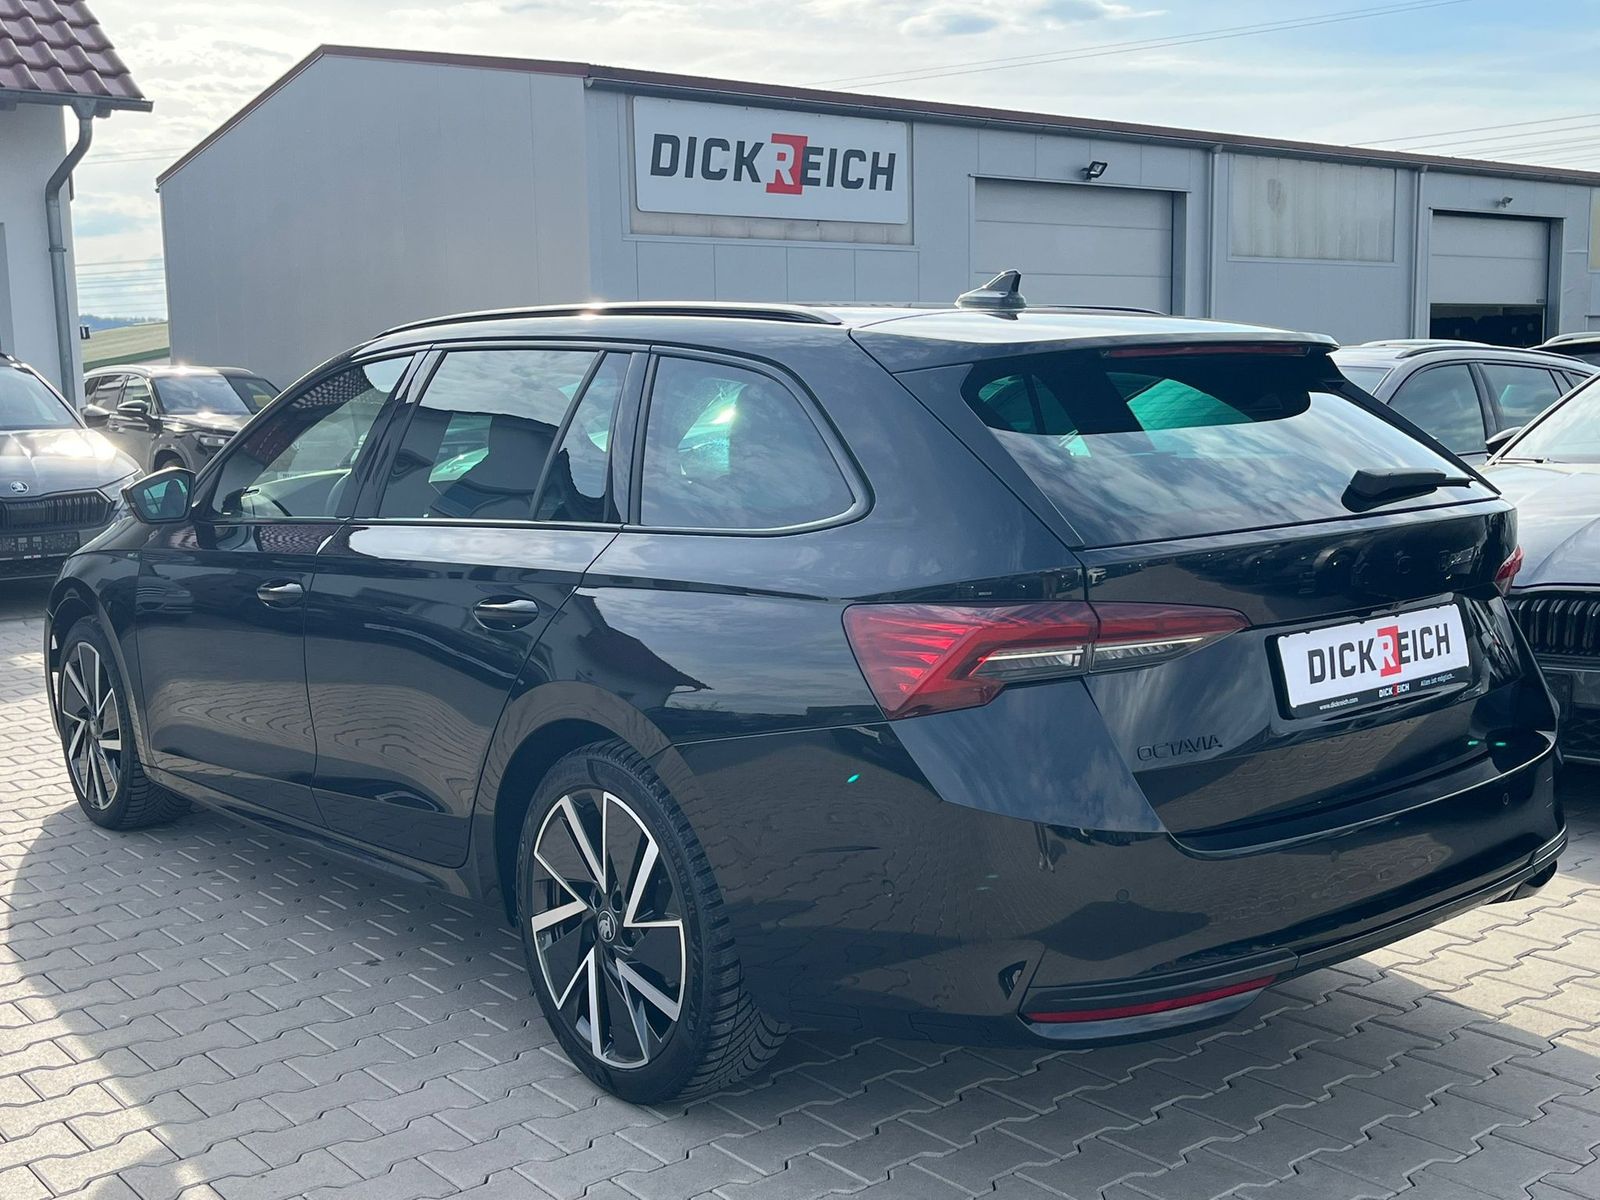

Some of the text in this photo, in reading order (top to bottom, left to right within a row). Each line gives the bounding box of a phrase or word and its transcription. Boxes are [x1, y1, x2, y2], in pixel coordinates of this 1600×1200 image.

[650, 133, 896, 195] DICKREICH
[1307, 623, 1451, 685] DICKREICH
[1137, 734, 1223, 761] OCTAVIA
